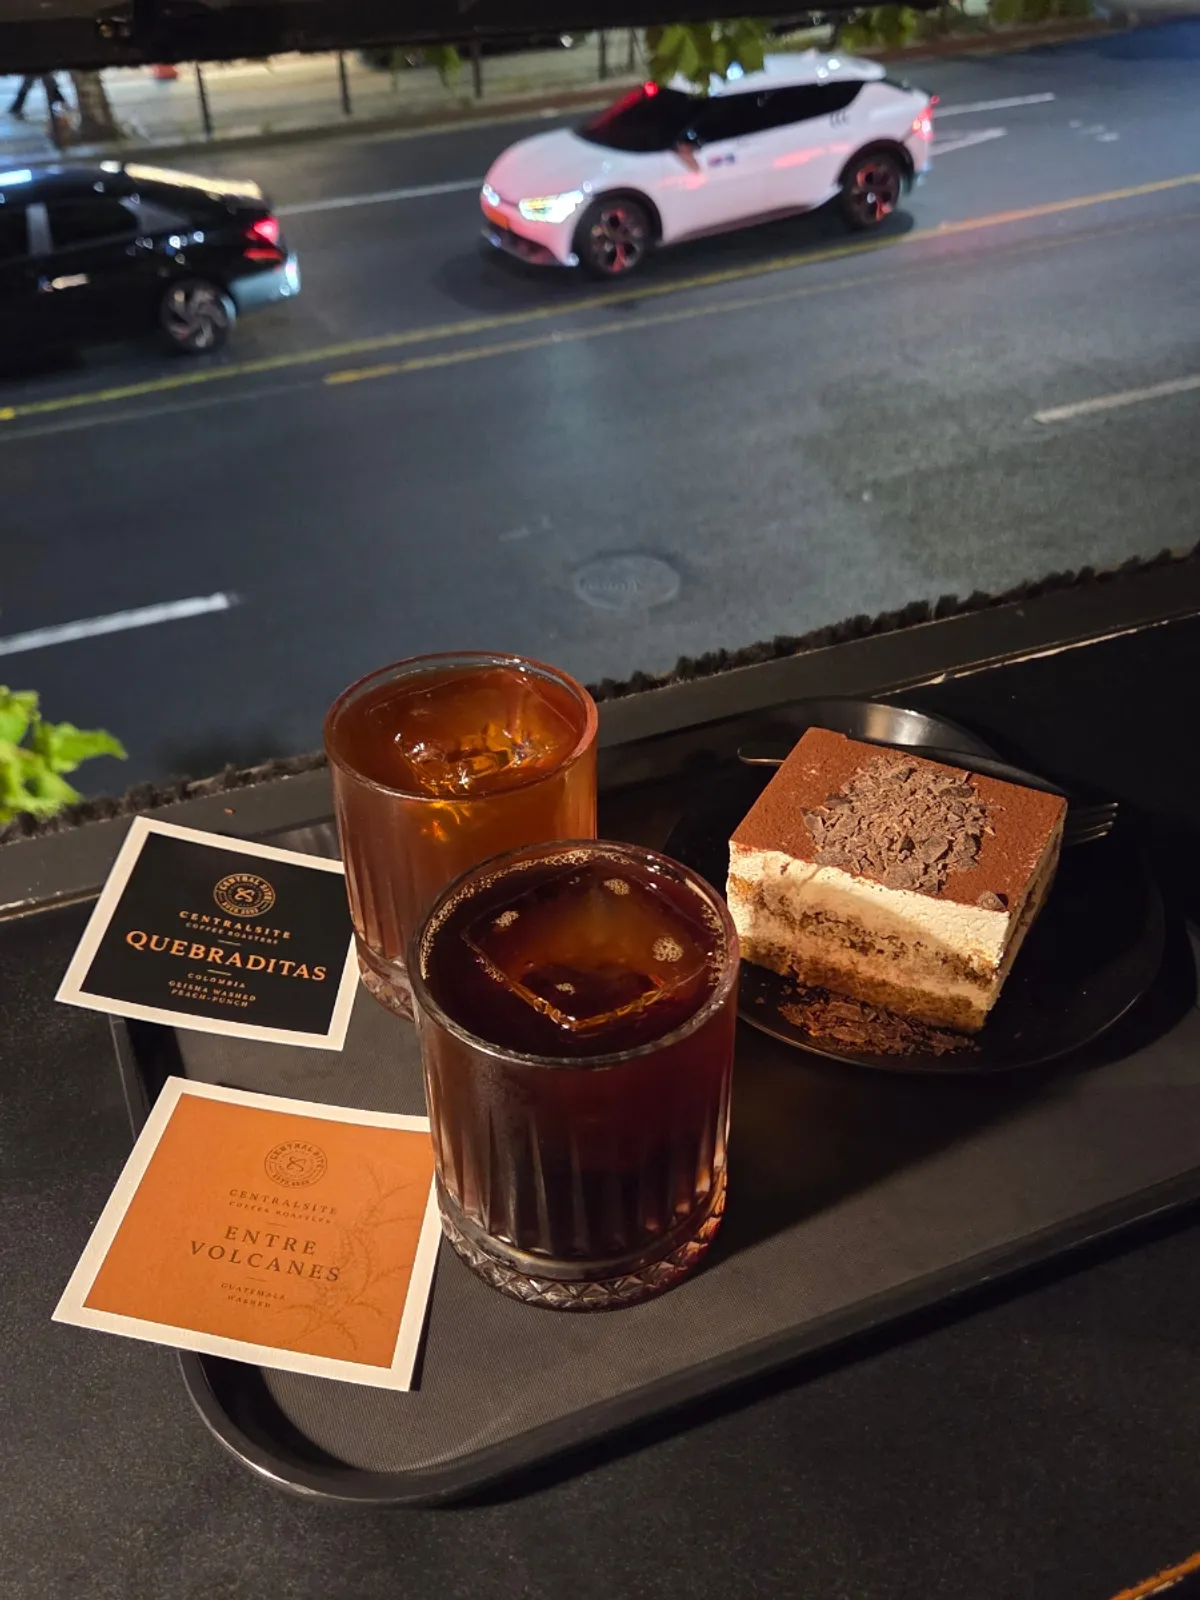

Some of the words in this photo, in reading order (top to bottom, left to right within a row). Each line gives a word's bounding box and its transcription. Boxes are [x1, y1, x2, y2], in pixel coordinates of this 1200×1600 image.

[218, 875, 260, 891] CENTRAL
[259, 883, 273, 901] SITE
[178, 910, 291, 939] CENTRALSITE
[185, 921, 225, 935] COFFEE
[227, 930, 278, 945] ROASTERS
[125, 929, 327, 982] QUEBRADITAS
[167, 980, 209, 993] GEISHA
[212, 988, 257, 1002] WASHED
[187, 972, 246, 989] COLOMBIA
[170, 988, 249, 1008] PEACH-PUNCH
[269, 1143, 313, 1160] CENTRAL
[312, 1150, 325, 1169] SITE
[229, 1189, 338, 1216] CENTRALSITE
[229, 1200, 270, 1214] COFFEE
[223, 1225, 317, 1256] ENTRE
[188, 1240, 342, 1283] VOLCANES
[220, 1282, 286, 1301] GUATEMALA
[227, 1294, 272, 1309] WASHED
